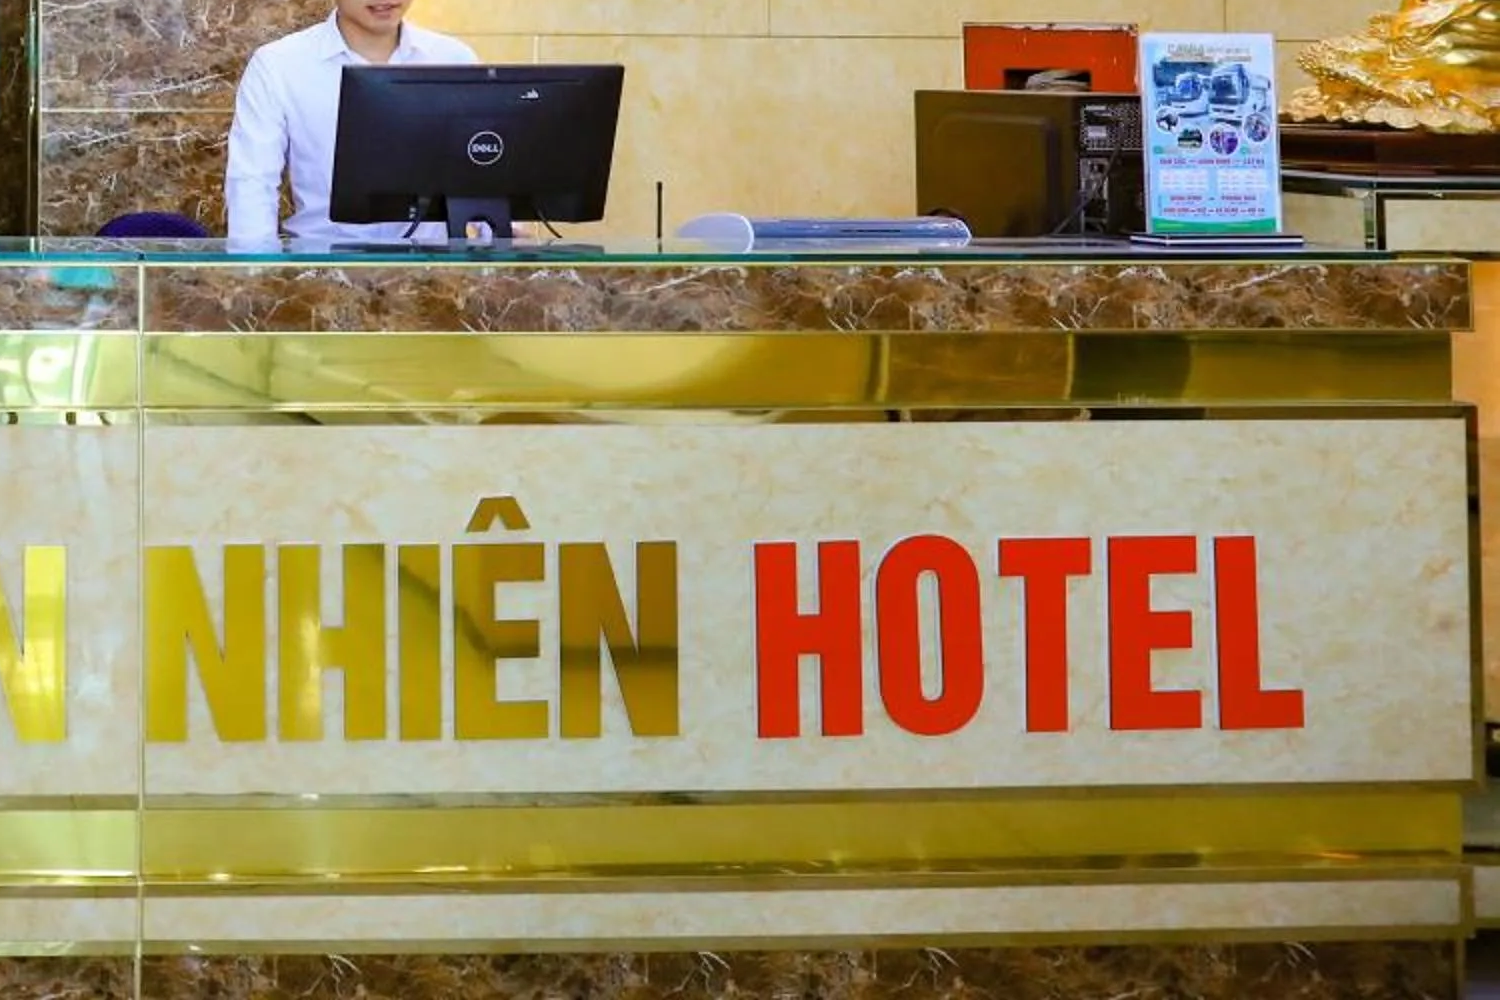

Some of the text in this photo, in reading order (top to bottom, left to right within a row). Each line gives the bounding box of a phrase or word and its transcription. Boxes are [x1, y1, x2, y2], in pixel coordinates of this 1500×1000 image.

[471, 143, 499, 153] DELL
[143, 496, 680, 742] NHIÊN
[752, 534, 1305, 738] HOTEL
